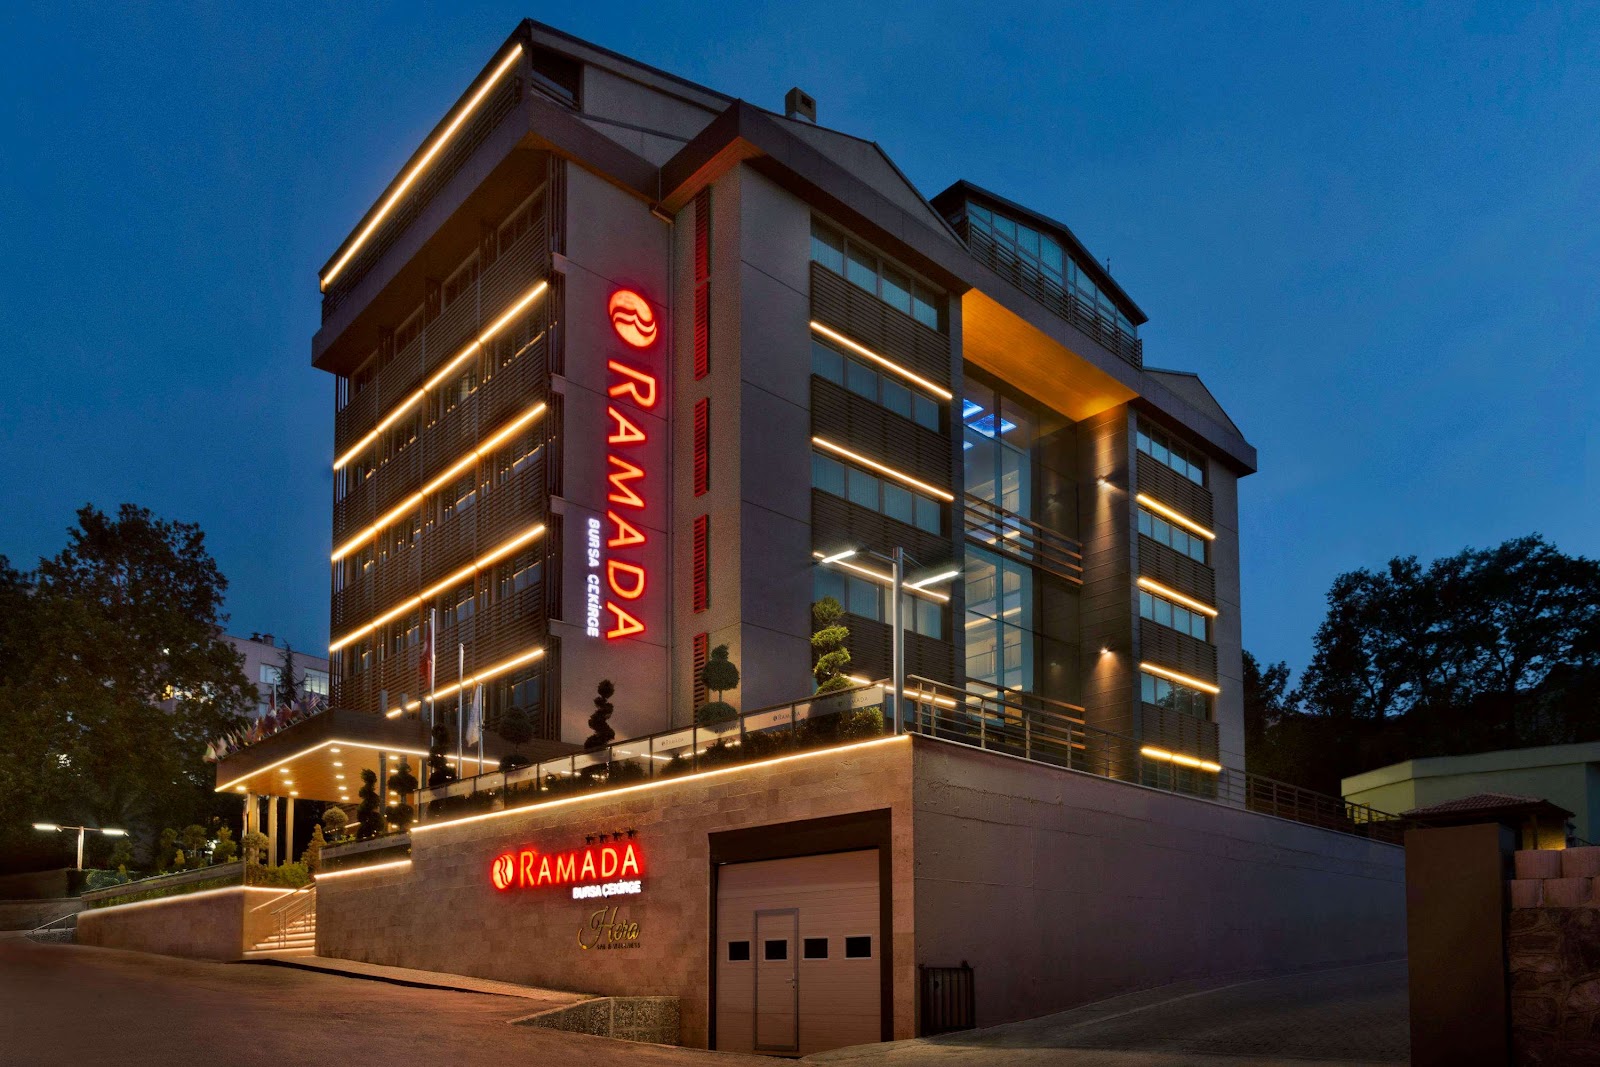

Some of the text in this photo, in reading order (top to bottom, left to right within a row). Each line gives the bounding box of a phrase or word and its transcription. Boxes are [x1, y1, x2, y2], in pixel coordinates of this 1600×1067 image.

[607, 360, 656, 640] RAMADA
[587, 517, 600, 568] BURSA
[520, 844, 640, 887] RAMADA
[572, 885, 602, 899] BURSA
[577, 905, 640, 950] Hera
